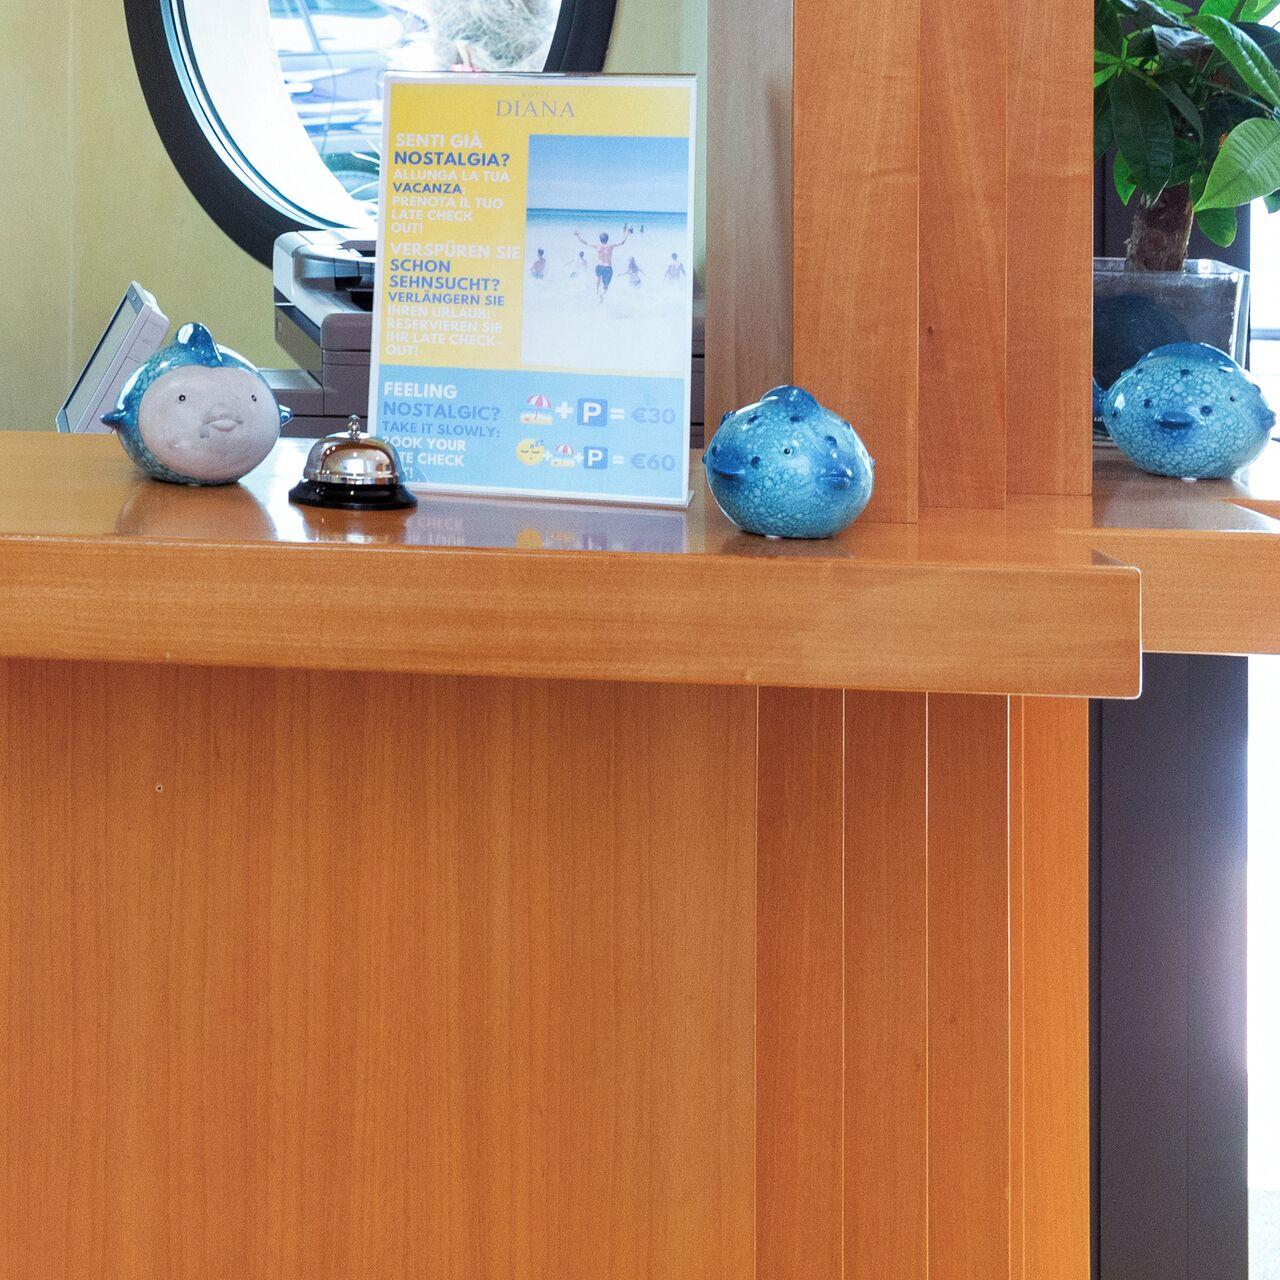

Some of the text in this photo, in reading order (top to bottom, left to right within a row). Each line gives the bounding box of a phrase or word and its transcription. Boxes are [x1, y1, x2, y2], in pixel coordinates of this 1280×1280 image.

[495, 99, 575, 118] DIANA
[395, 130, 483, 149] SENTI GIÀ
[394, 151, 510, 167] NOSTALGIA?
[392, 169, 510, 183] ALLUNGA LA TUA
[392, 196, 504, 209] PRENOTA IL TUO
[391, 209, 472, 221] LATE CHECK
[390, 222, 424, 234] OUT!
[390, 239, 521, 260] VERSPÜREN SIE
[390, 258, 451, 273] SCHON
[389, 275, 500, 291] SEHNSUCHT?
[389, 289, 505, 306] VERLÄNGERN SIE
[387, 306, 428, 317] IHREN
[387, 318, 503, 333] RESERVIEREN SIE
[387, 331, 409, 343] IHR
[412, 332, 446, 345] LATE
[383, 381, 458, 399] FEELING
[383, 401, 501, 420] NOSTALGIC?
[630, 406, 676, 425] €30
[382, 421, 501, 438] TAKE IT SLOWLY:
[427, 437, 466, 451] YOUR
[417, 452, 464, 466] CHECK
[630, 452, 676, 471] €60
